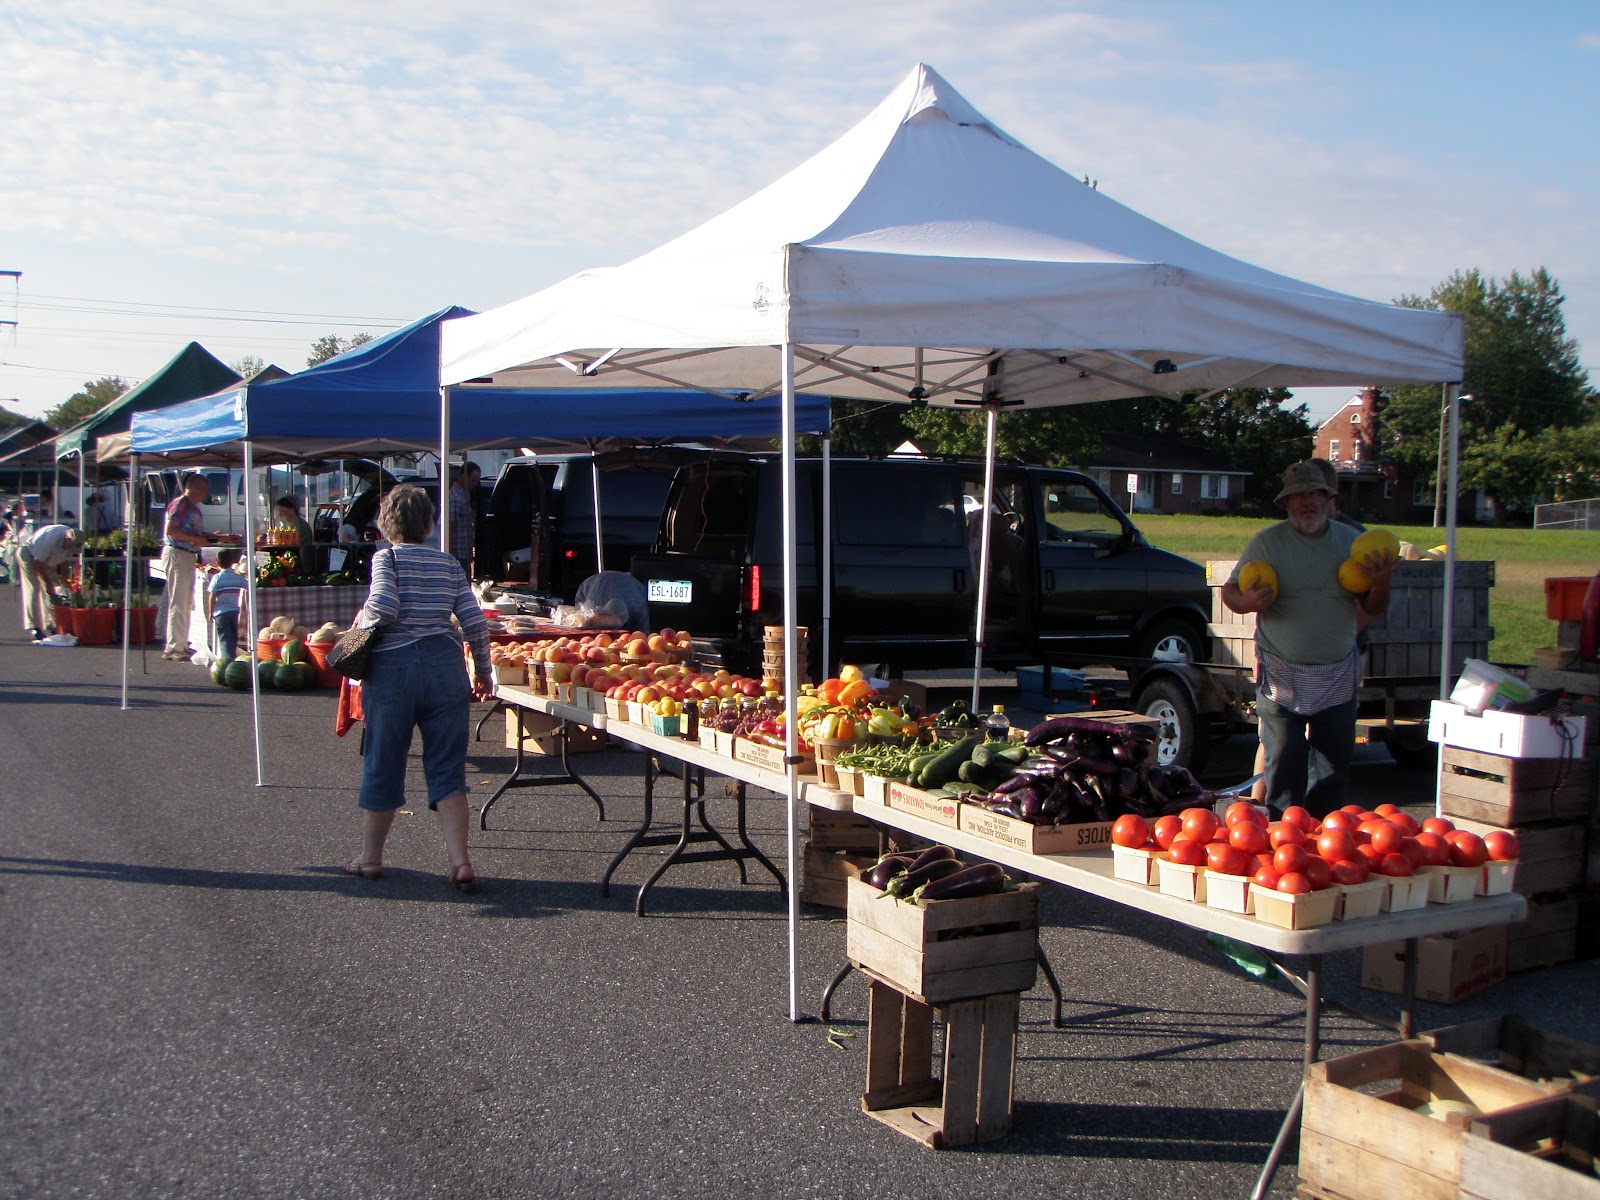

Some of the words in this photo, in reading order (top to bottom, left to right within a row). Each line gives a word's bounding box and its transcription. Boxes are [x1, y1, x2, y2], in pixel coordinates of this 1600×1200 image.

[903, 793, 925, 810] TOMATOES
[994, 830, 1012, 844] PRODUCE
[1077, 826, 1112, 845] ATOES
